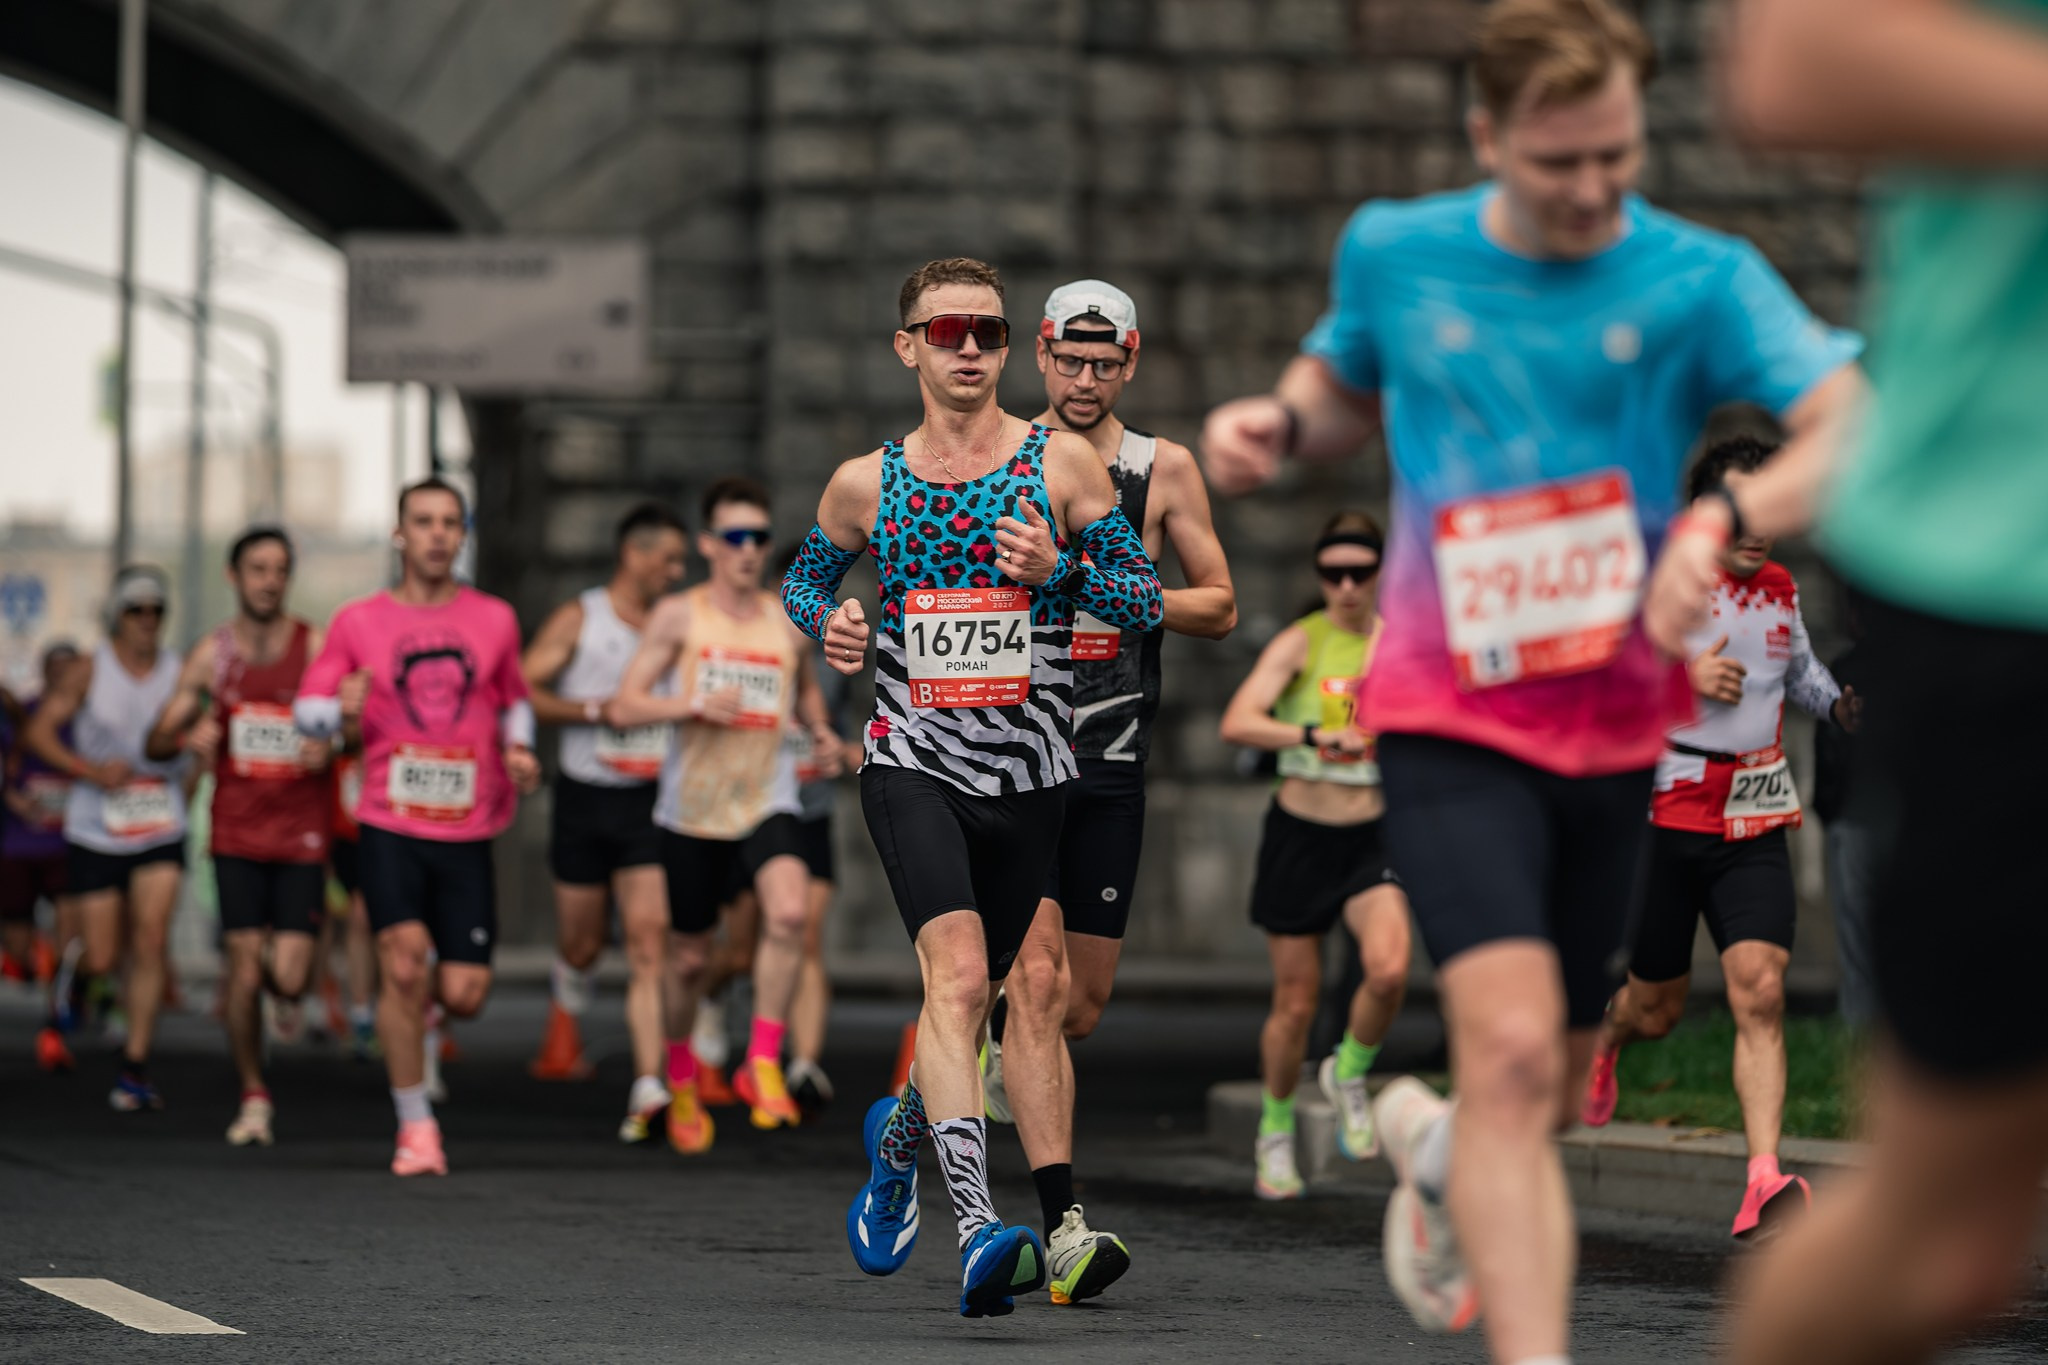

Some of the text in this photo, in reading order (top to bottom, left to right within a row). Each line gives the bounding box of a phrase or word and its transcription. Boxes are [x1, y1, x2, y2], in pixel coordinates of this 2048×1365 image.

[1456, 534, 1639, 622] 29402
[911, 619, 1026, 657] 16754
[946, 660, 988, 672] РОМАН
[919, 683, 934, 704] B
